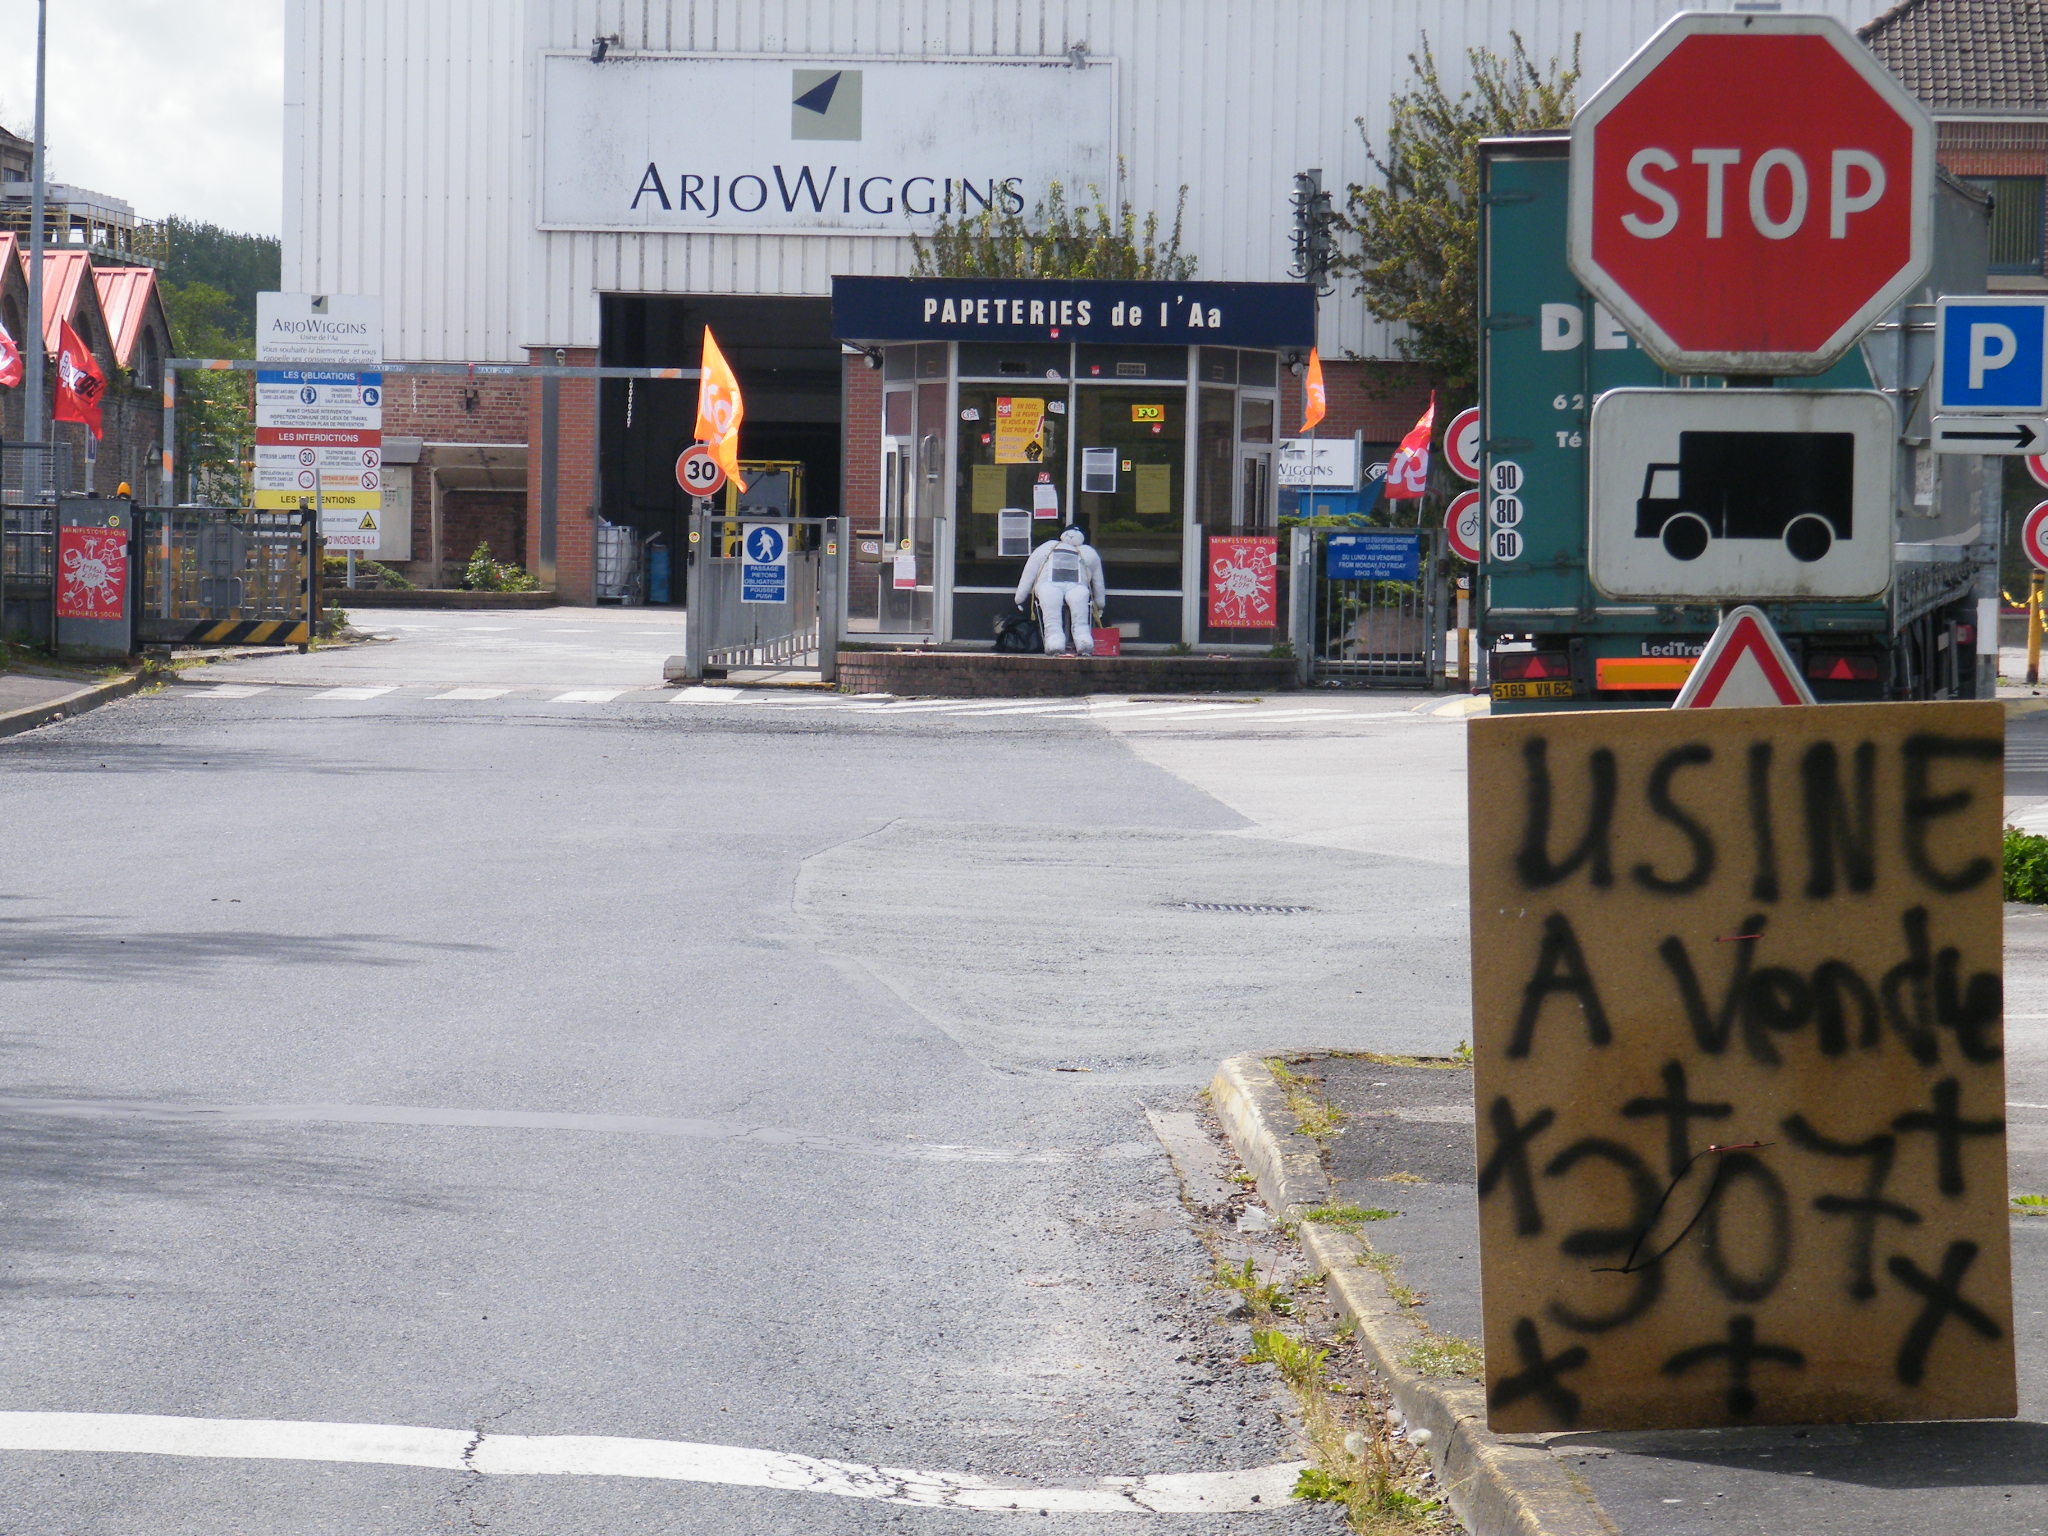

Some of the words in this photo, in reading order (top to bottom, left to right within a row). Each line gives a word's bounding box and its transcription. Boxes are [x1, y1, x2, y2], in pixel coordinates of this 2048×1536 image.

[1621, 147, 1886, 240] STOP
[924, 298, 1091, 327] PAPETERIES
[1111, 301, 1142, 328] de
[1968, 322, 2017, 390] P
[283, 371, 299, 379] LES
[300, 371, 355, 380] OBLIGATIONS
[998, 404, 1011, 413] cgt
[1137, 408, 1159, 418] FO
[278, 432, 295, 441] LES
[296, 434, 359, 442] INTERDICTIONS
[302, 452, 312, 462] 30
[687, 460, 716, 480] 30
[1496, 465, 1516, 490] 90
[280, 495, 297, 503] LES
[1496, 499, 1516, 524] 80
[1496, 533, 1516, 557] 60
[1494, 684, 1526, 698] 5189
[1516, 733, 2004, 901] USINE
[1507, 909, 1611, 1058] A
